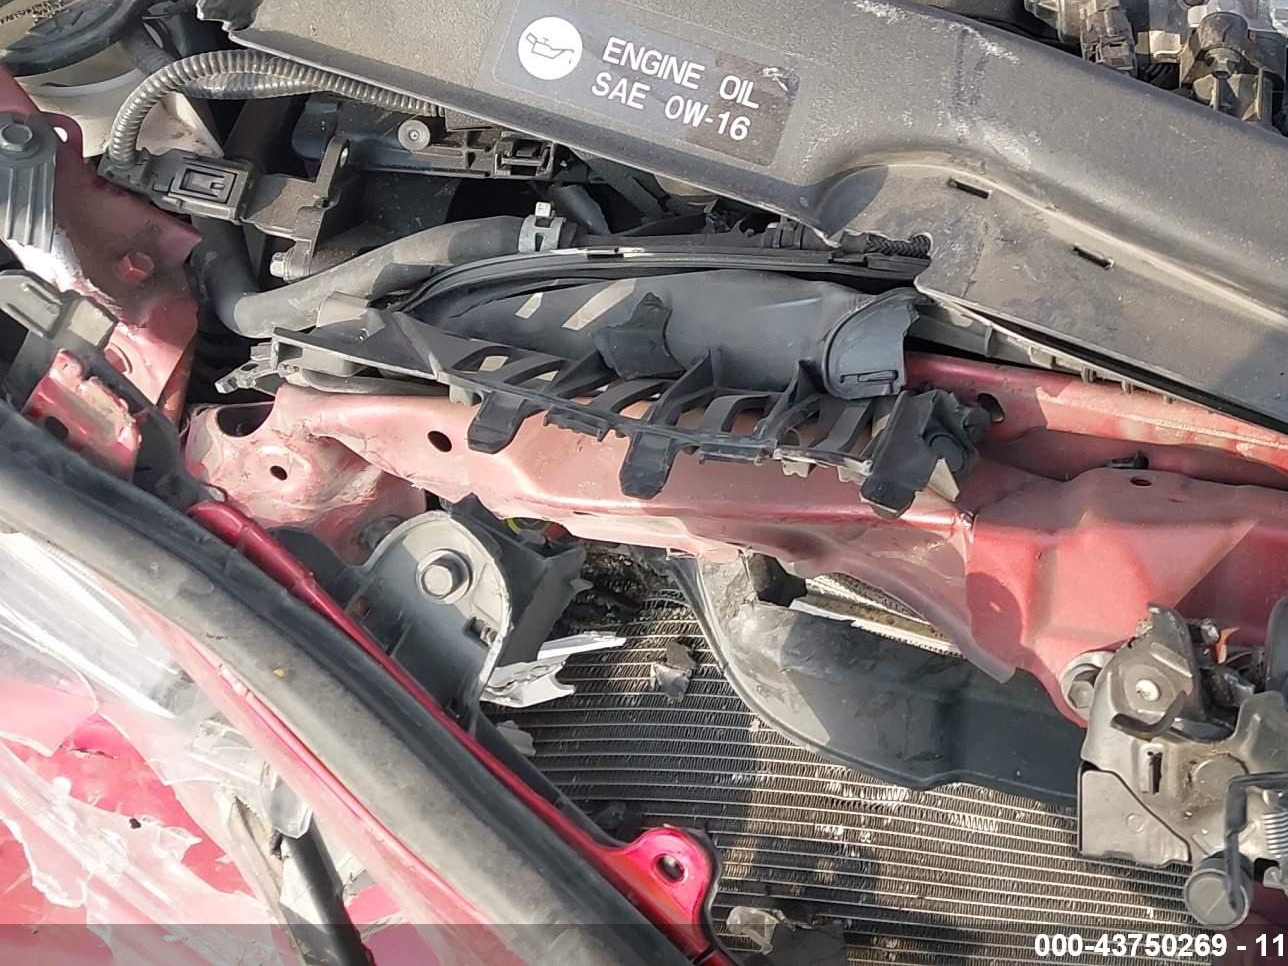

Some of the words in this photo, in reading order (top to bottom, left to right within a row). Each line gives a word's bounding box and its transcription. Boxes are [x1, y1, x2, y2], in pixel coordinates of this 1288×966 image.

[591, 71, 650, 110] SAE
[664, 95, 751, 141] 0W-16
[602, 36, 706, 90] ENGINE
[719, 75, 760, 109] OIL
